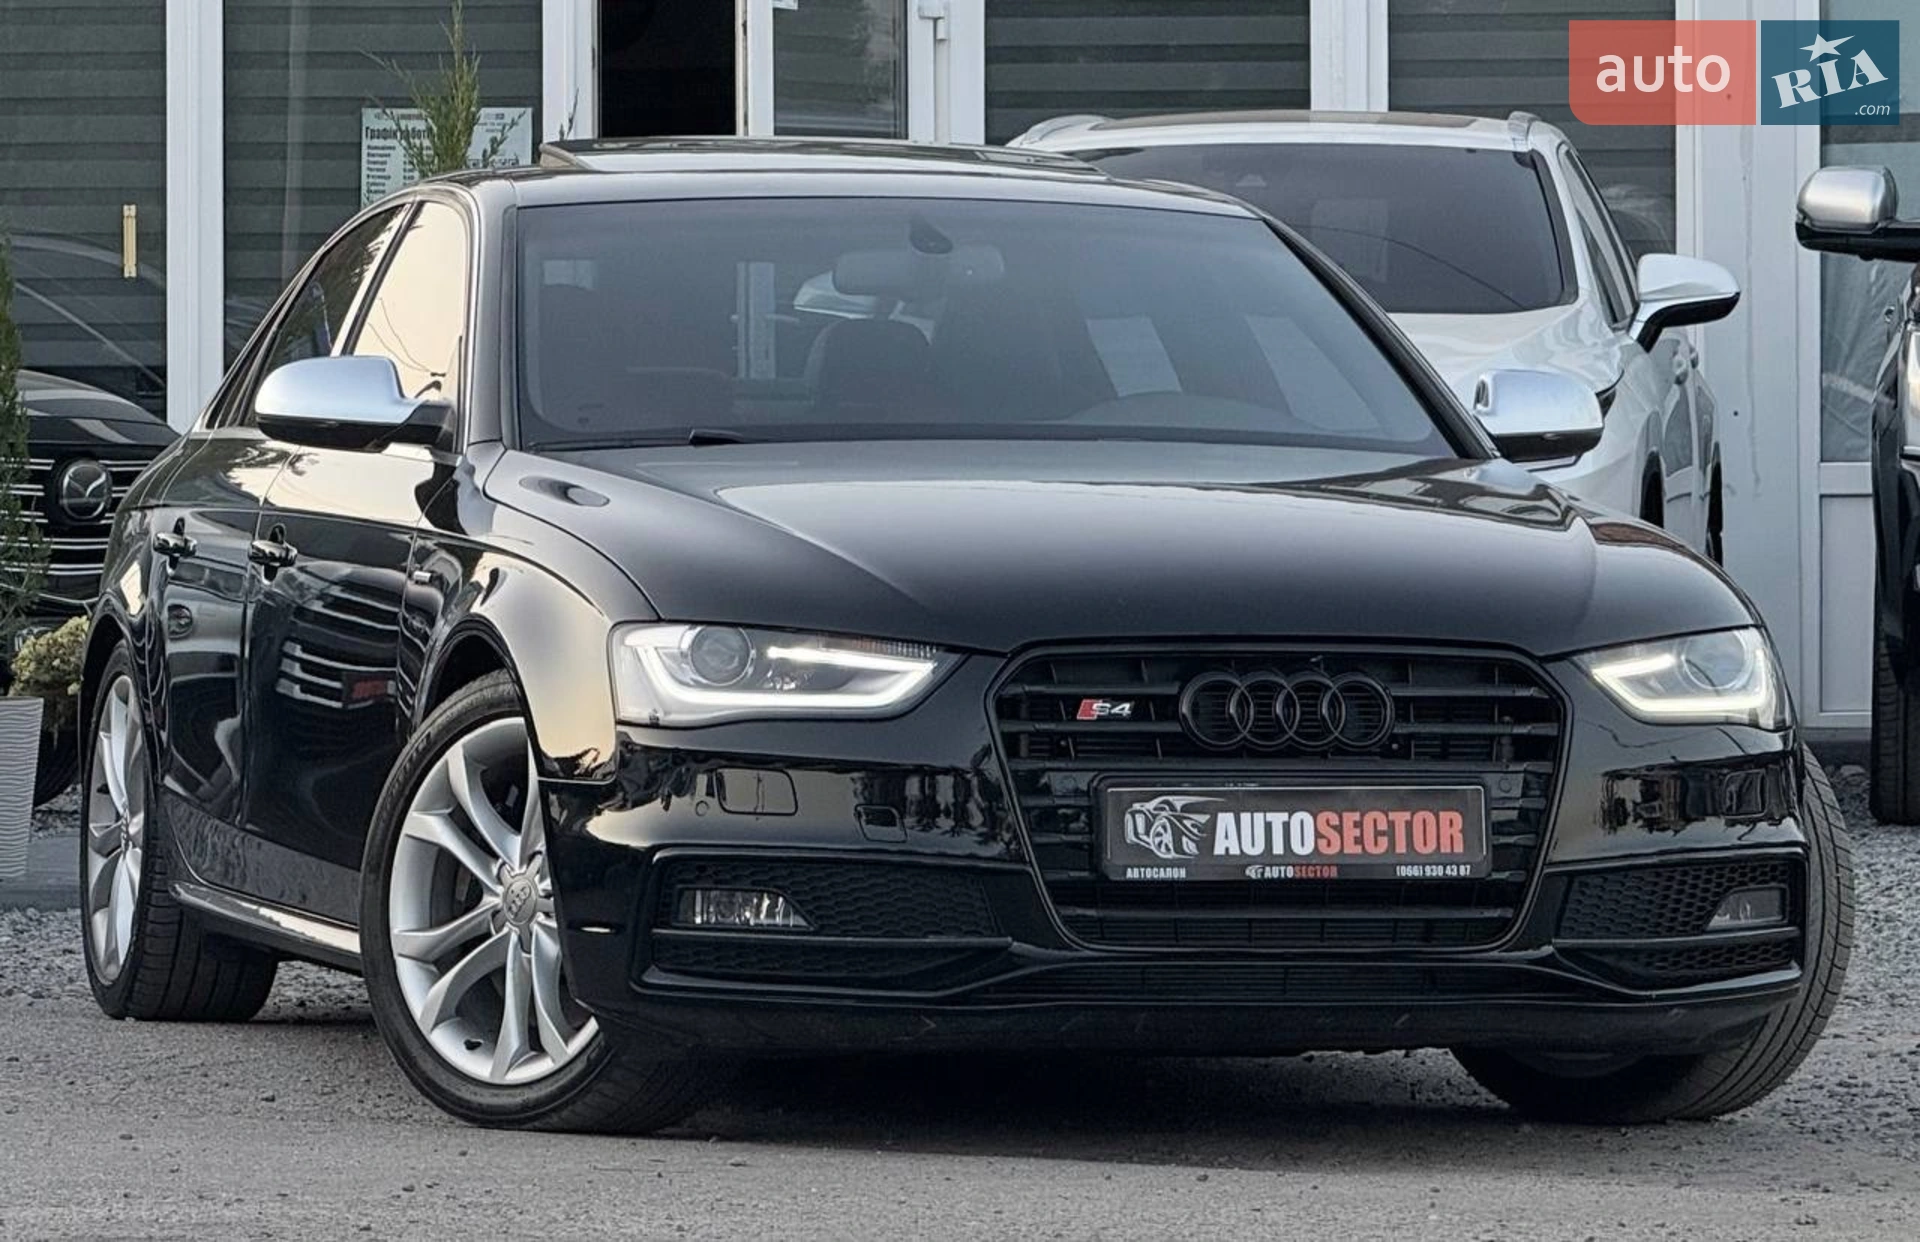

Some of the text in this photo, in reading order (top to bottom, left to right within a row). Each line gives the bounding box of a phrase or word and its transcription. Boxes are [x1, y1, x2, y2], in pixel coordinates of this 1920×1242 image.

[1090, 702, 1132, 717] S4
[1213, 810, 1465, 856] AUTOSECTOR
[1126, 867, 1187, 879] АВТОСАЛОН
[1263, 866, 1338, 879] AUTOSECTOR
[1424, 864, 1444, 877] 930
[1445, 864, 1458, 877] 43
